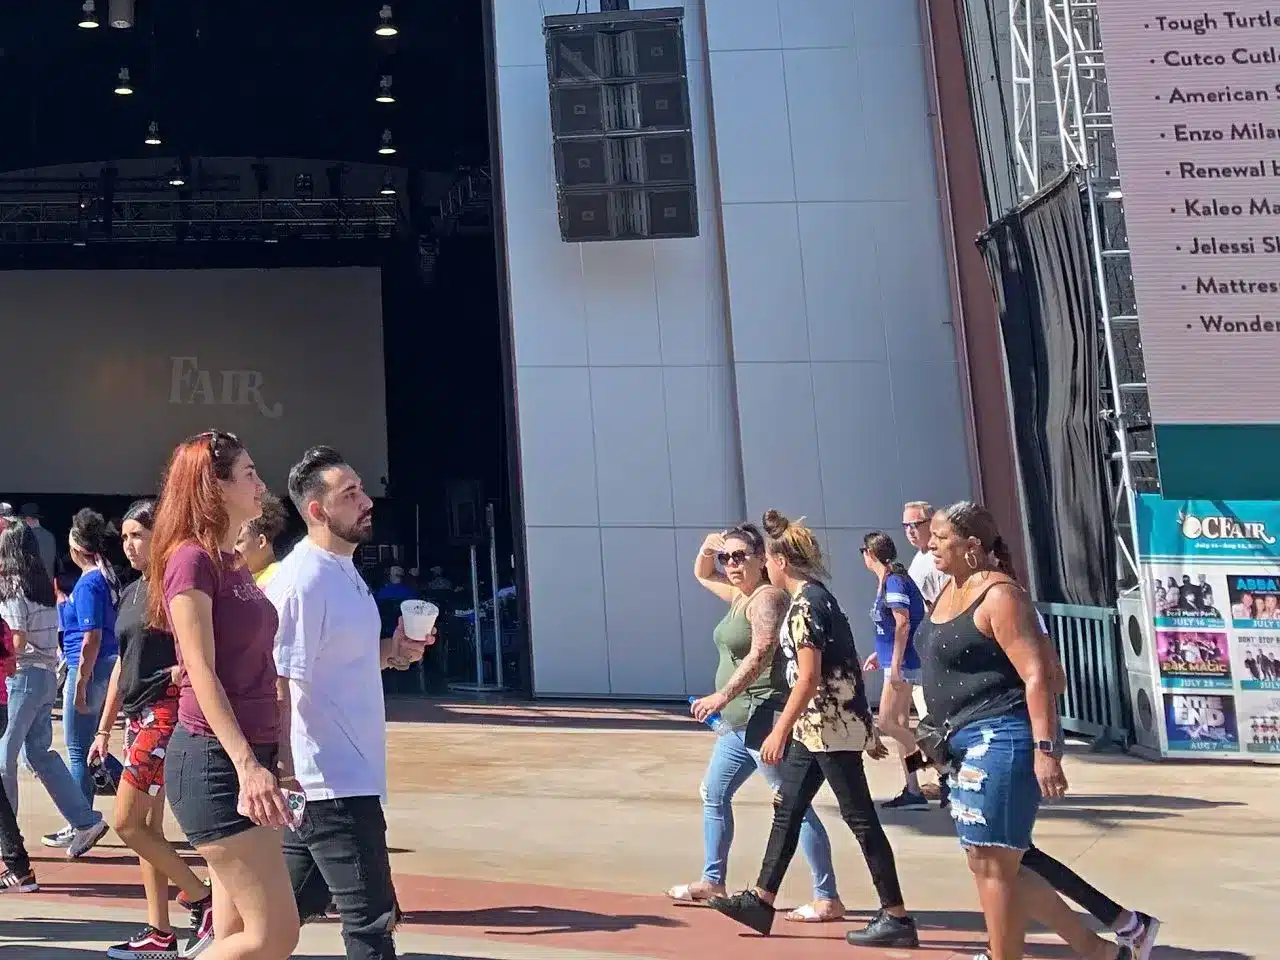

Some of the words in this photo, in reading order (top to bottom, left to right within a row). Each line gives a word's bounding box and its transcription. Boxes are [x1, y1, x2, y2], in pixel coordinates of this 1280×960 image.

[1155, 12, 1218, 35] Tough
[1164, 50, 1225, 66] Cutco
[1231, 46, 1280, 64] Cutl
[1169, 86, 1269, 103] American
[1174, 123, 1224, 141] Enzo
[1231, 122, 1280, 140] Mila
[1179, 160, 1266, 178] Renewal
[1185, 198, 1242, 216] Kaleo
[1189, 236, 1255, 254] Jelessi
[1196, 276, 1280, 294] Mattres
[1174, 708, 1225, 726] END
